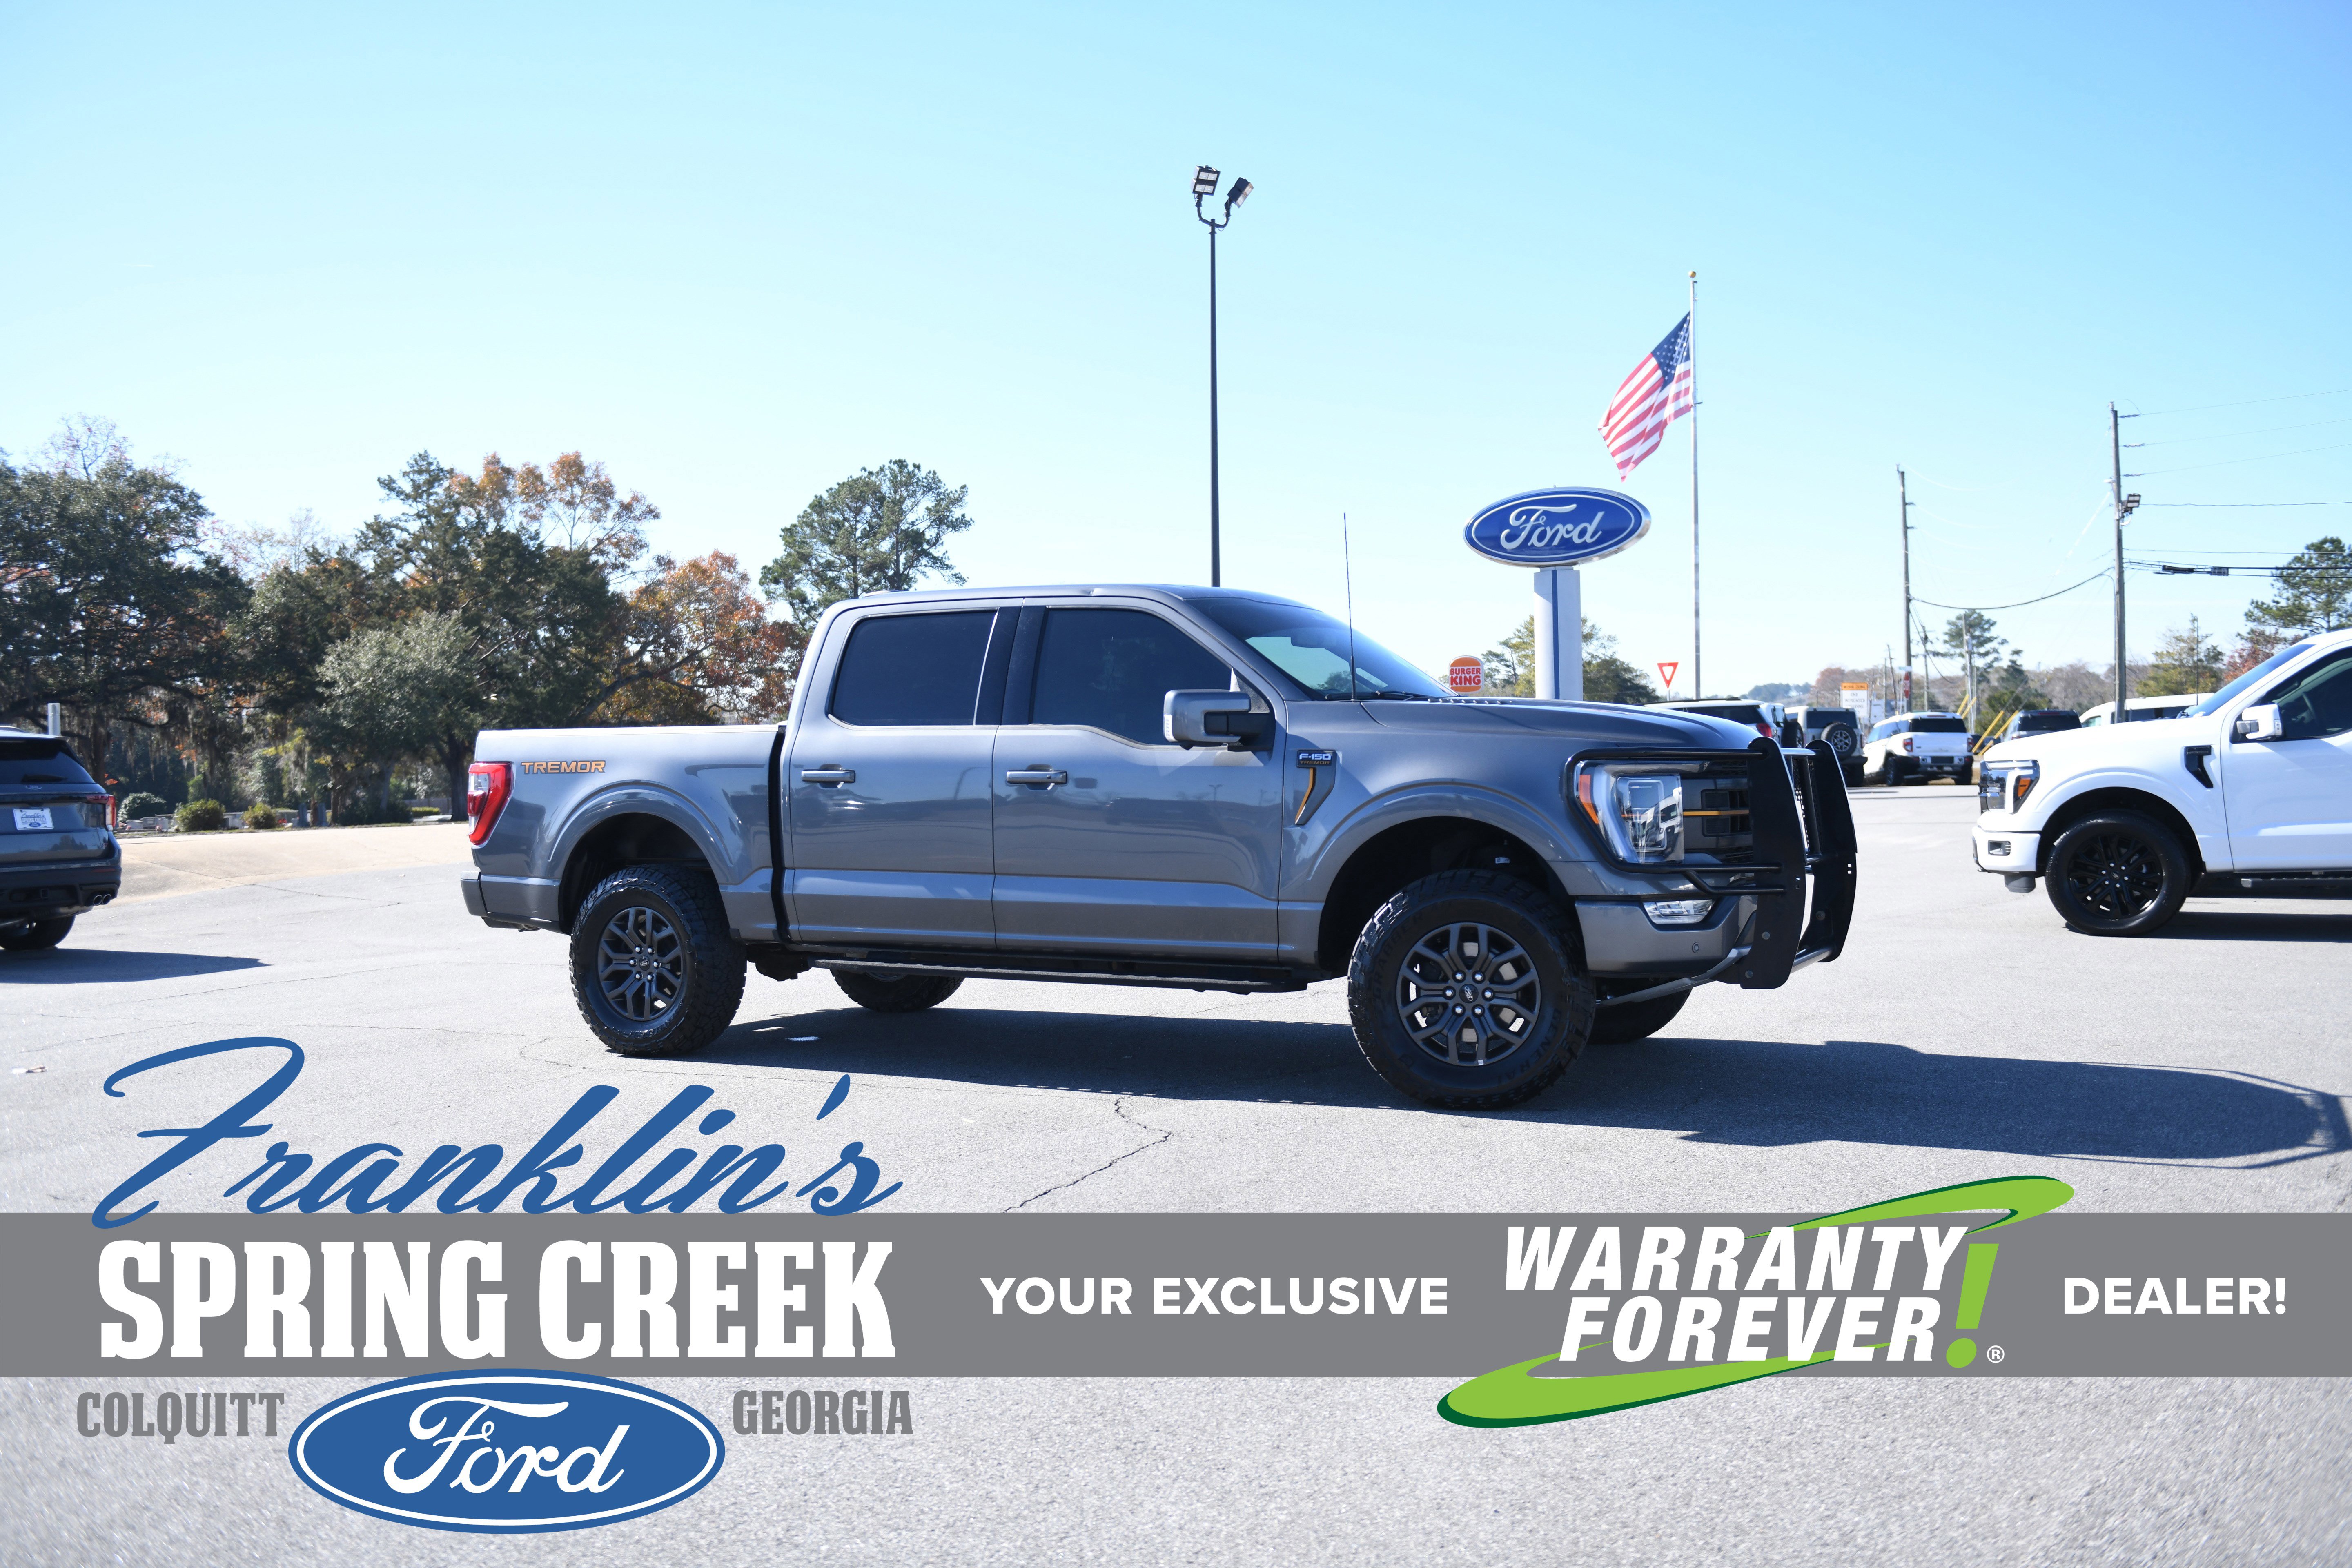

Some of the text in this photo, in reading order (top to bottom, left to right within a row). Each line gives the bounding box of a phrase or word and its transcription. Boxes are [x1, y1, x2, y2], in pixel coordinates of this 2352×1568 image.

[1500, 503, 1605, 550] Ford
[1450, 675, 1481, 686] KING
[521, 761, 606, 773] TREMOR
